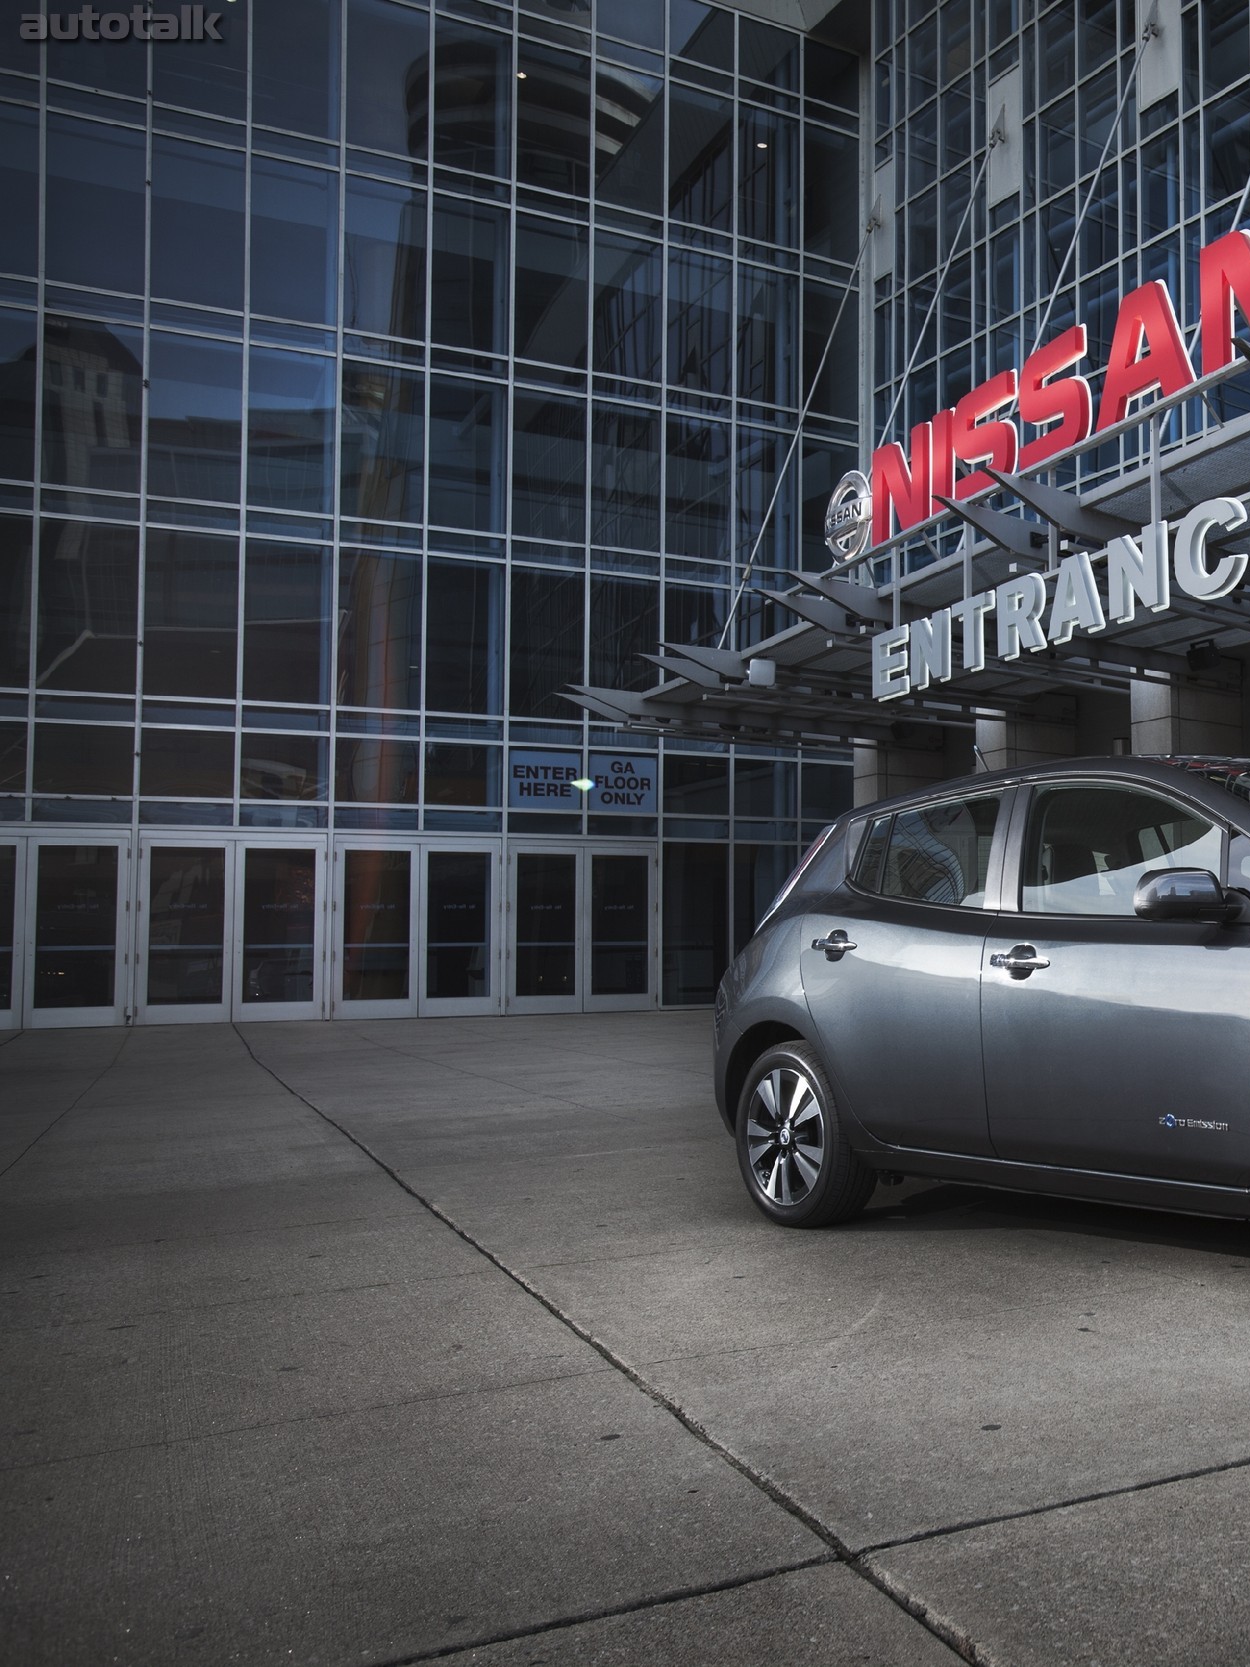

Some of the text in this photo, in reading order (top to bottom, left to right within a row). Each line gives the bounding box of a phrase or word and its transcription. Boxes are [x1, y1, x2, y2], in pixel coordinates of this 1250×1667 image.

[513, 764, 578, 782] ENTER
[610, 761, 635, 775] GA
[519, 782, 572, 797] HERE
[594, 775, 651, 791] FLOOR
[600, 791, 645, 806] ONLY
